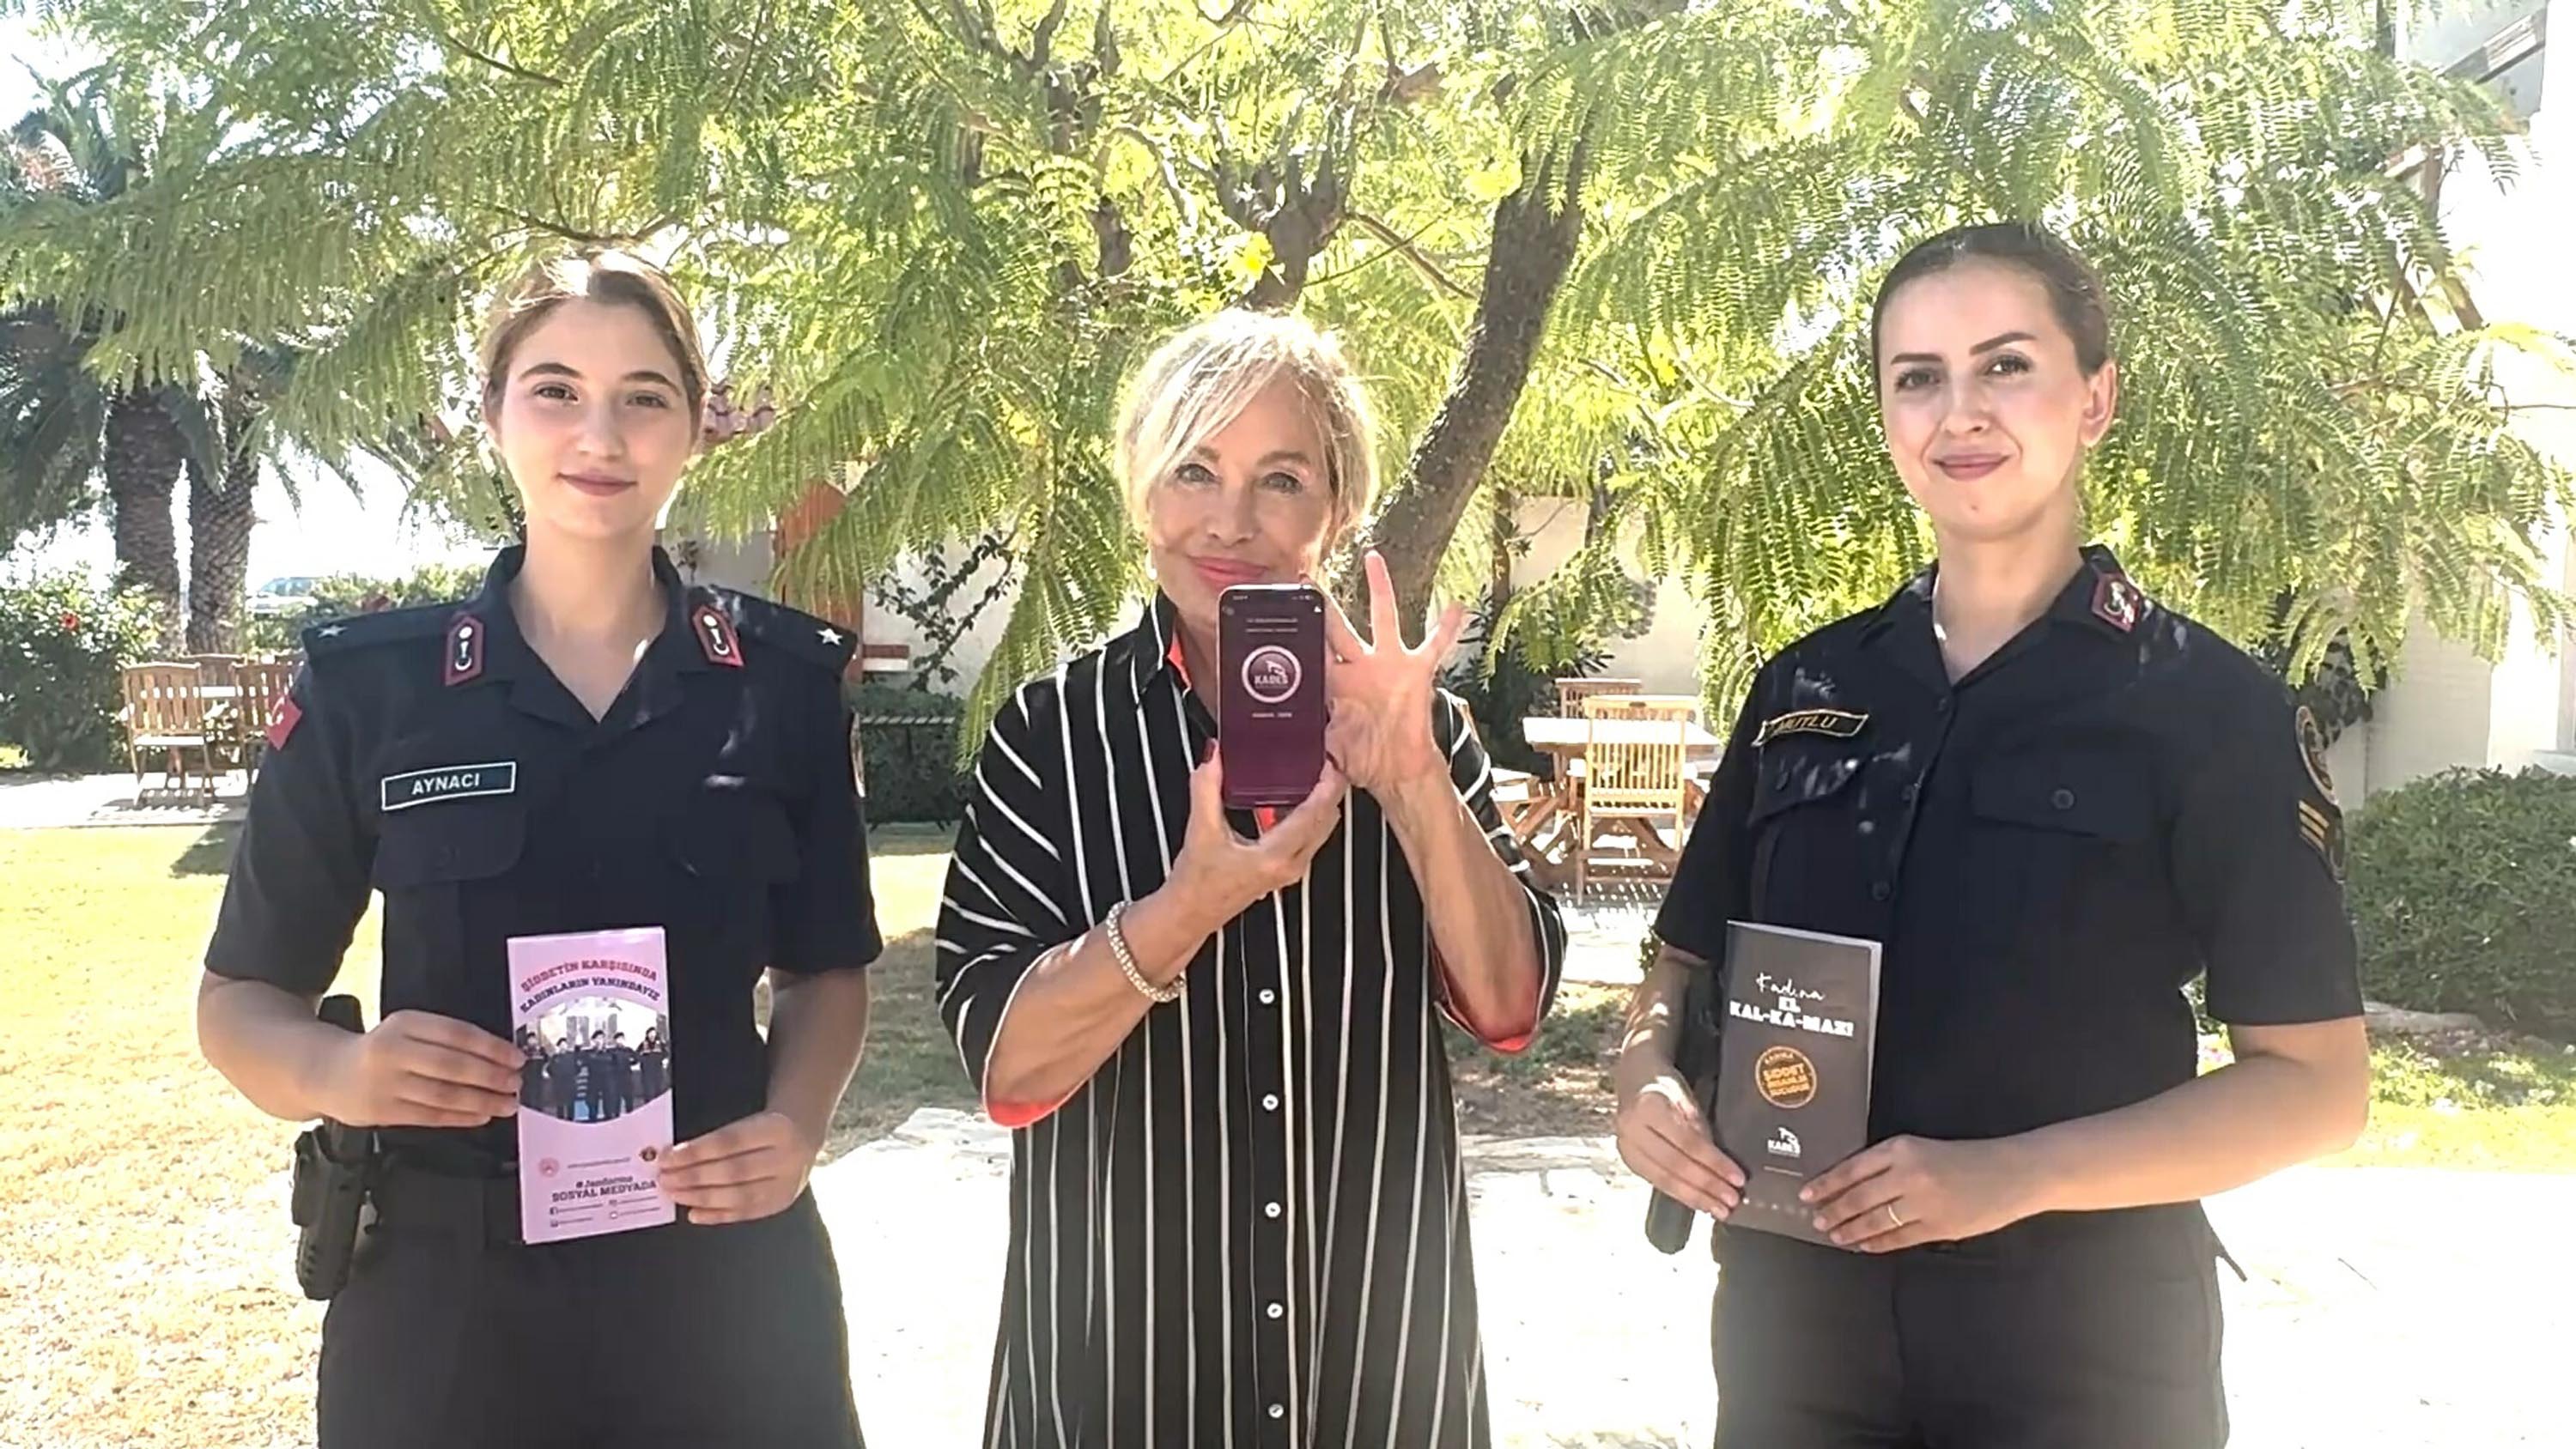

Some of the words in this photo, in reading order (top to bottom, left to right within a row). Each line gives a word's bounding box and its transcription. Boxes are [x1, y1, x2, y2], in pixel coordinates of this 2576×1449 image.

[411, 773, 480, 795] AYNACI
[552, 1186, 598, 1203] SOSYAL
[600, 1179, 657, 1197] MEDYADA
